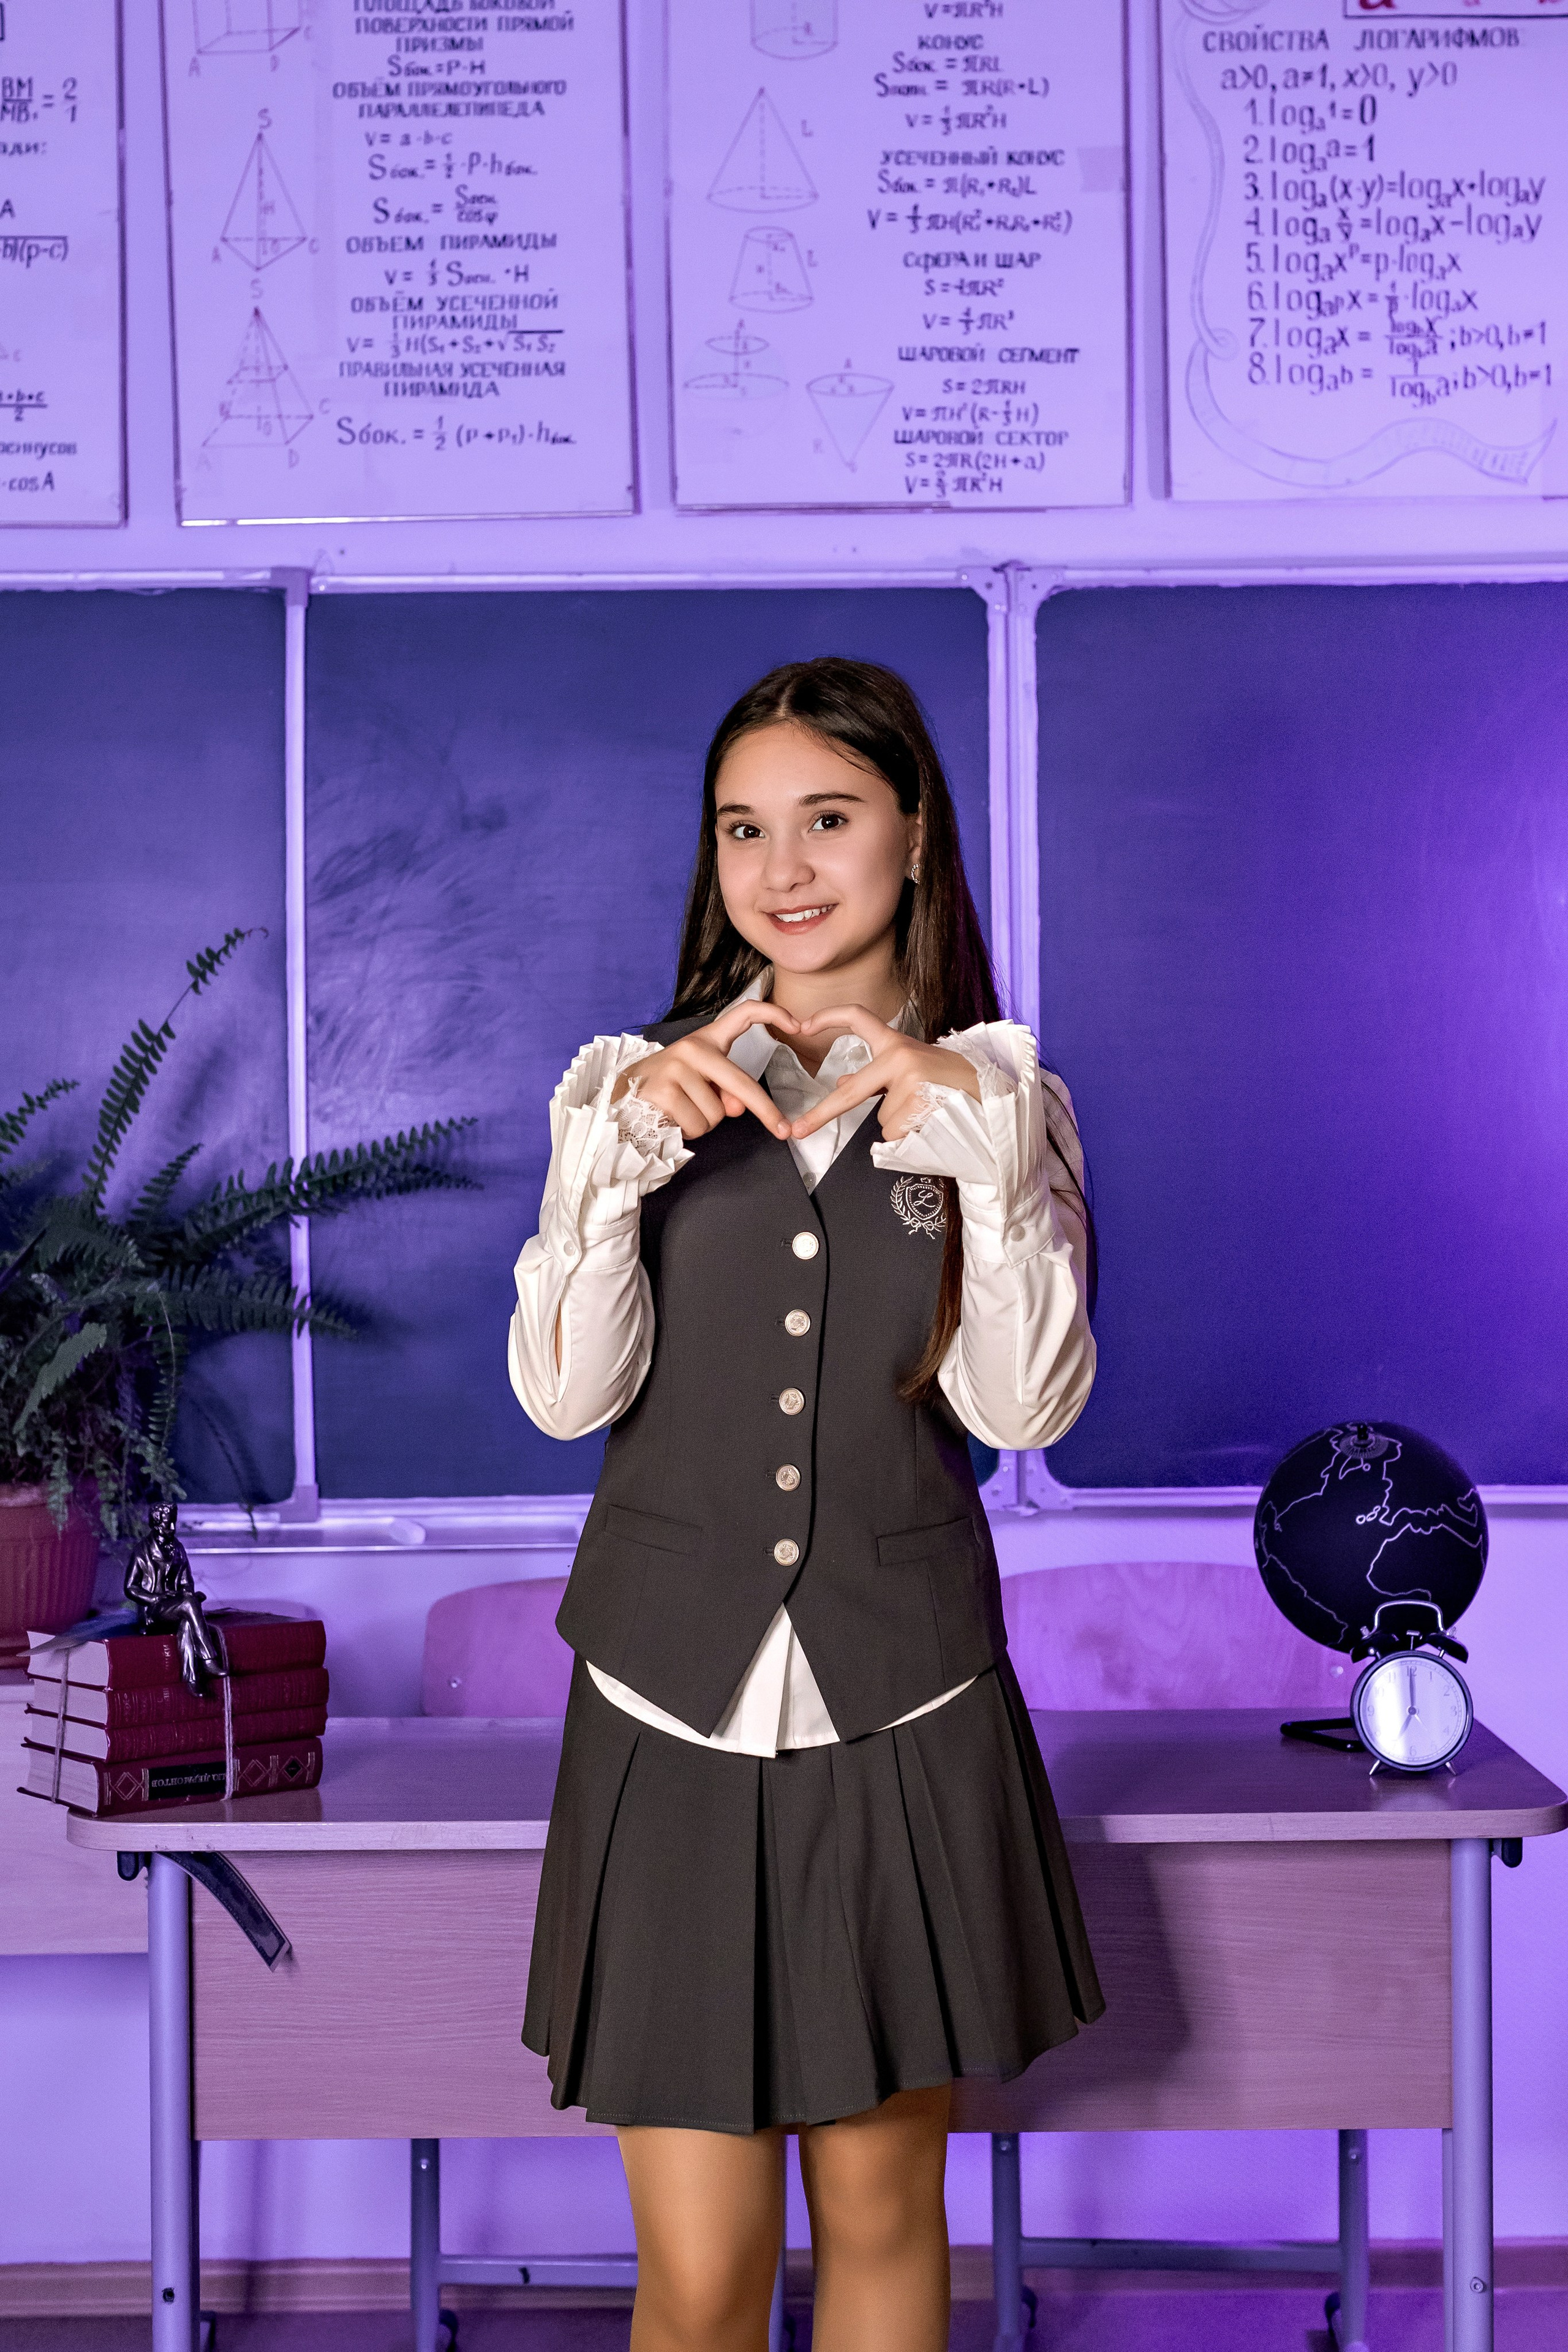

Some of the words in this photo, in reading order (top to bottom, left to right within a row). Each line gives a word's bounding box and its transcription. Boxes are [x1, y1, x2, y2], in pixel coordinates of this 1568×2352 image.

[355, 16, 489, 34] ПОВЕРХНОСТИ
[497, 10, 575, 31] ПРЯМОЙ
[395, 36, 484, 53] ПРИЗМЫ
[1202, 23, 1330, 53] СВОЙСТВА
[1353, 26, 1520, 52] ЛОГАРИФМОВ
[440, 233, 557, 251] ПИРАМИДЫ
[392, 314, 518, 331] ПИРАМИДЫ
[383, 381, 500, 399] ПИРАМИДА
